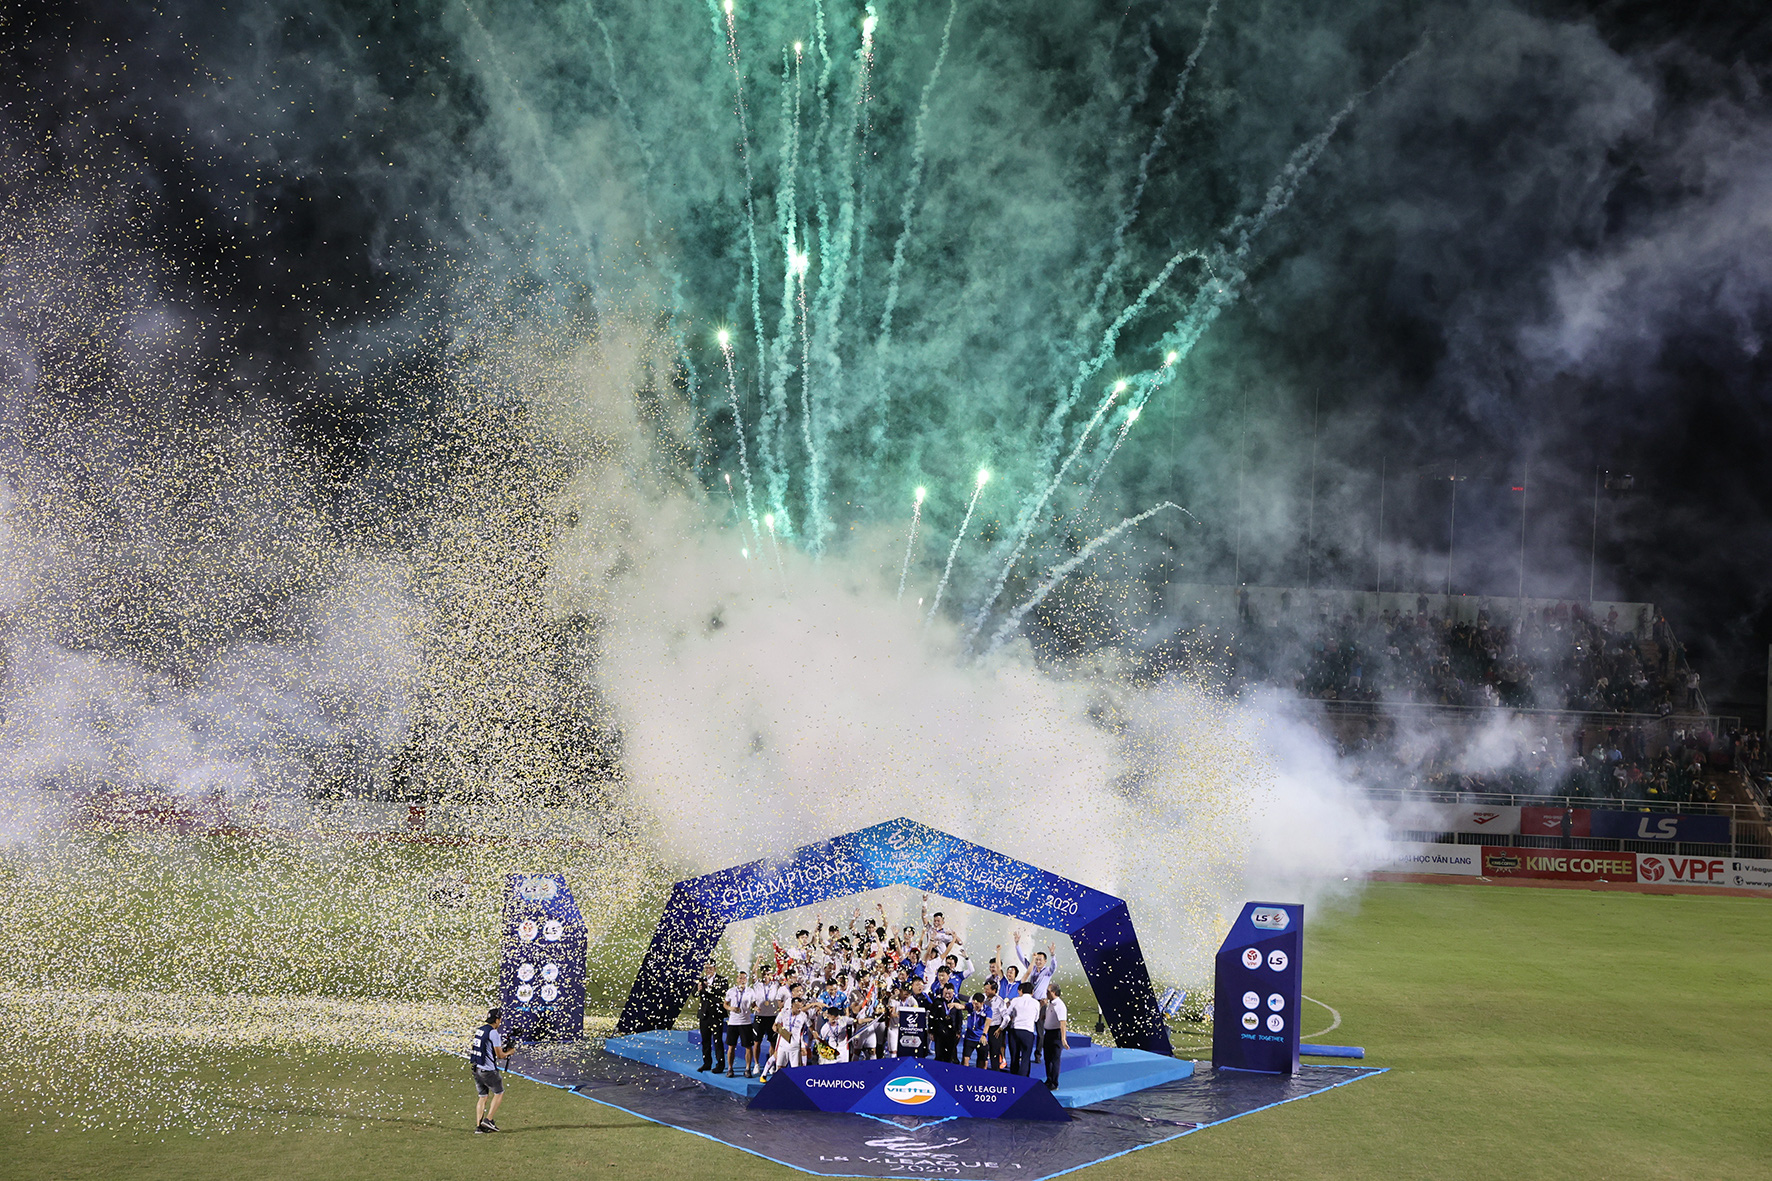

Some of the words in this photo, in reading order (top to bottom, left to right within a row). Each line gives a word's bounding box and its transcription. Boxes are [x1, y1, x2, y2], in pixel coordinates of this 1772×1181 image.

[1637, 817, 1678, 839] LS
[1413, 855, 1431, 864] HỌC
[1432, 854, 1448, 864] VĂN
[1449, 856, 1472, 865] LANG
[1526, 856, 1567, 874] KING
[1570, 858, 1633, 875] COFFEE
[1668, 858, 1725, 880] VPF
[722, 861, 852, 906] CHAMPIONS
[1044, 894, 1079, 915] 2020
[1255, 914, 1268, 922] LS
[1269, 956, 1283, 965] LS
[805, 1079, 866, 1090] CHAMPIONS
[954, 1084, 964, 1092] LS
[966, 1085, 1008, 1094] V.LEAGUE
[1011, 1086, 1016, 1094] 1
[974, 1094, 997, 1103] 2020
[858, 1156, 999, 1168] V.LEAGUE
